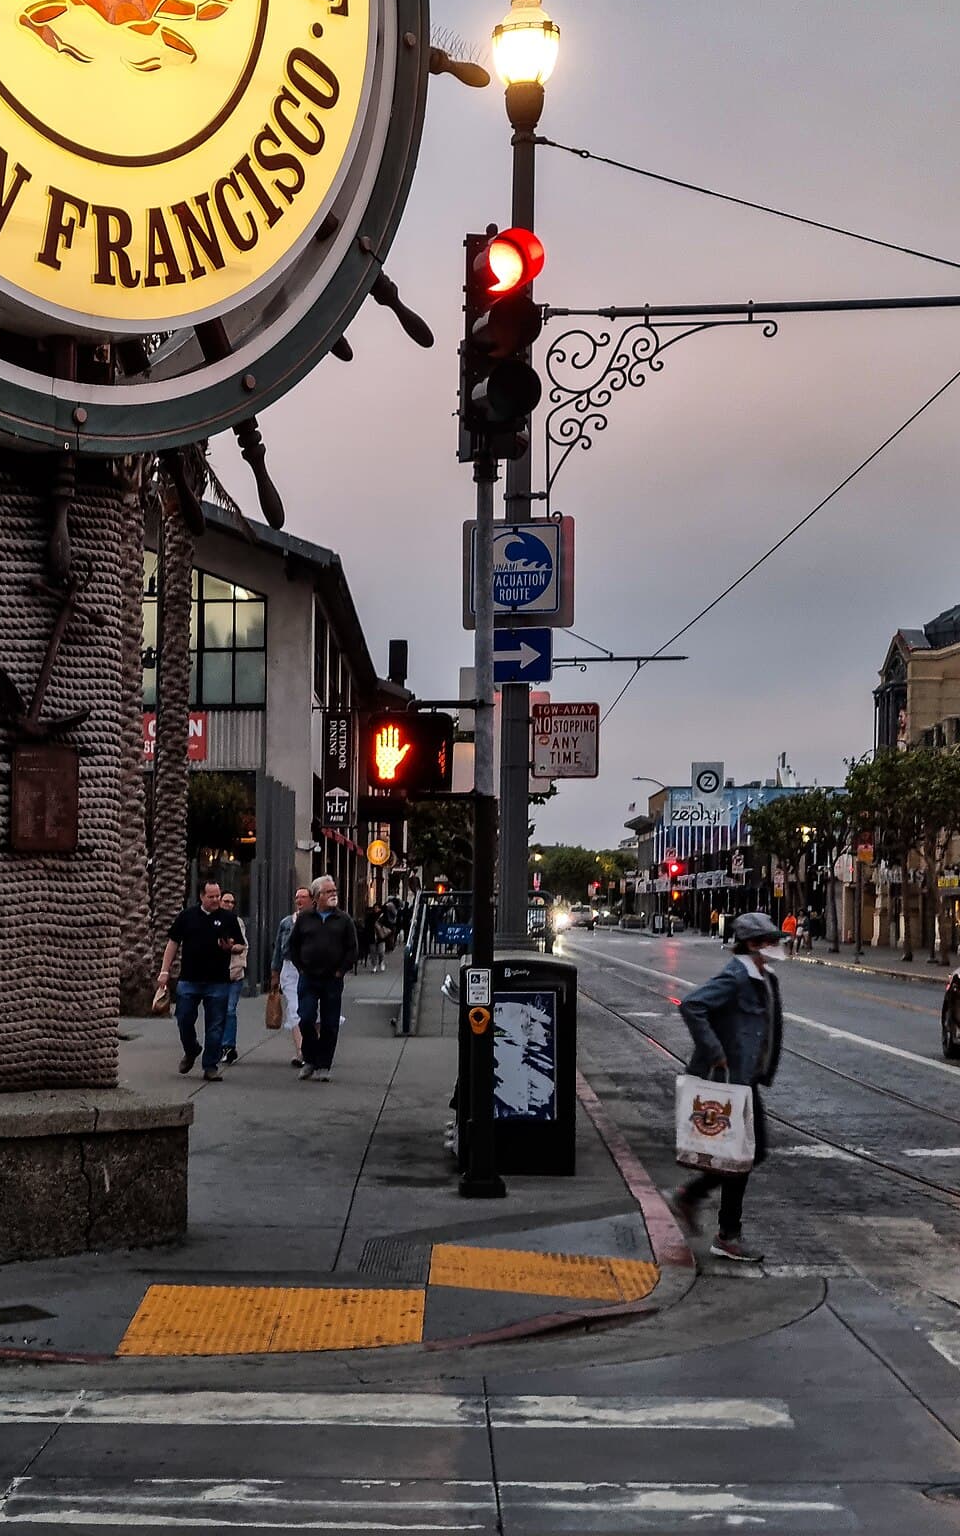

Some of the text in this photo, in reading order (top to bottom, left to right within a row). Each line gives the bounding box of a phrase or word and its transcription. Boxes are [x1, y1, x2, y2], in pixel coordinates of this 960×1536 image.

[38, 47, 338, 289] FRANCISCO
[499, 588, 531, 601] ROUTE
[538, 705, 594, 715] TOW-AWAY
[535, 716, 595, 733] NO STOPPING
[330, 720, 338, 756] DINING
[339, 719, 347, 769] OUTDOOR
[552, 737, 579, 749] ANY
[550, 751, 581, 764] TIME
